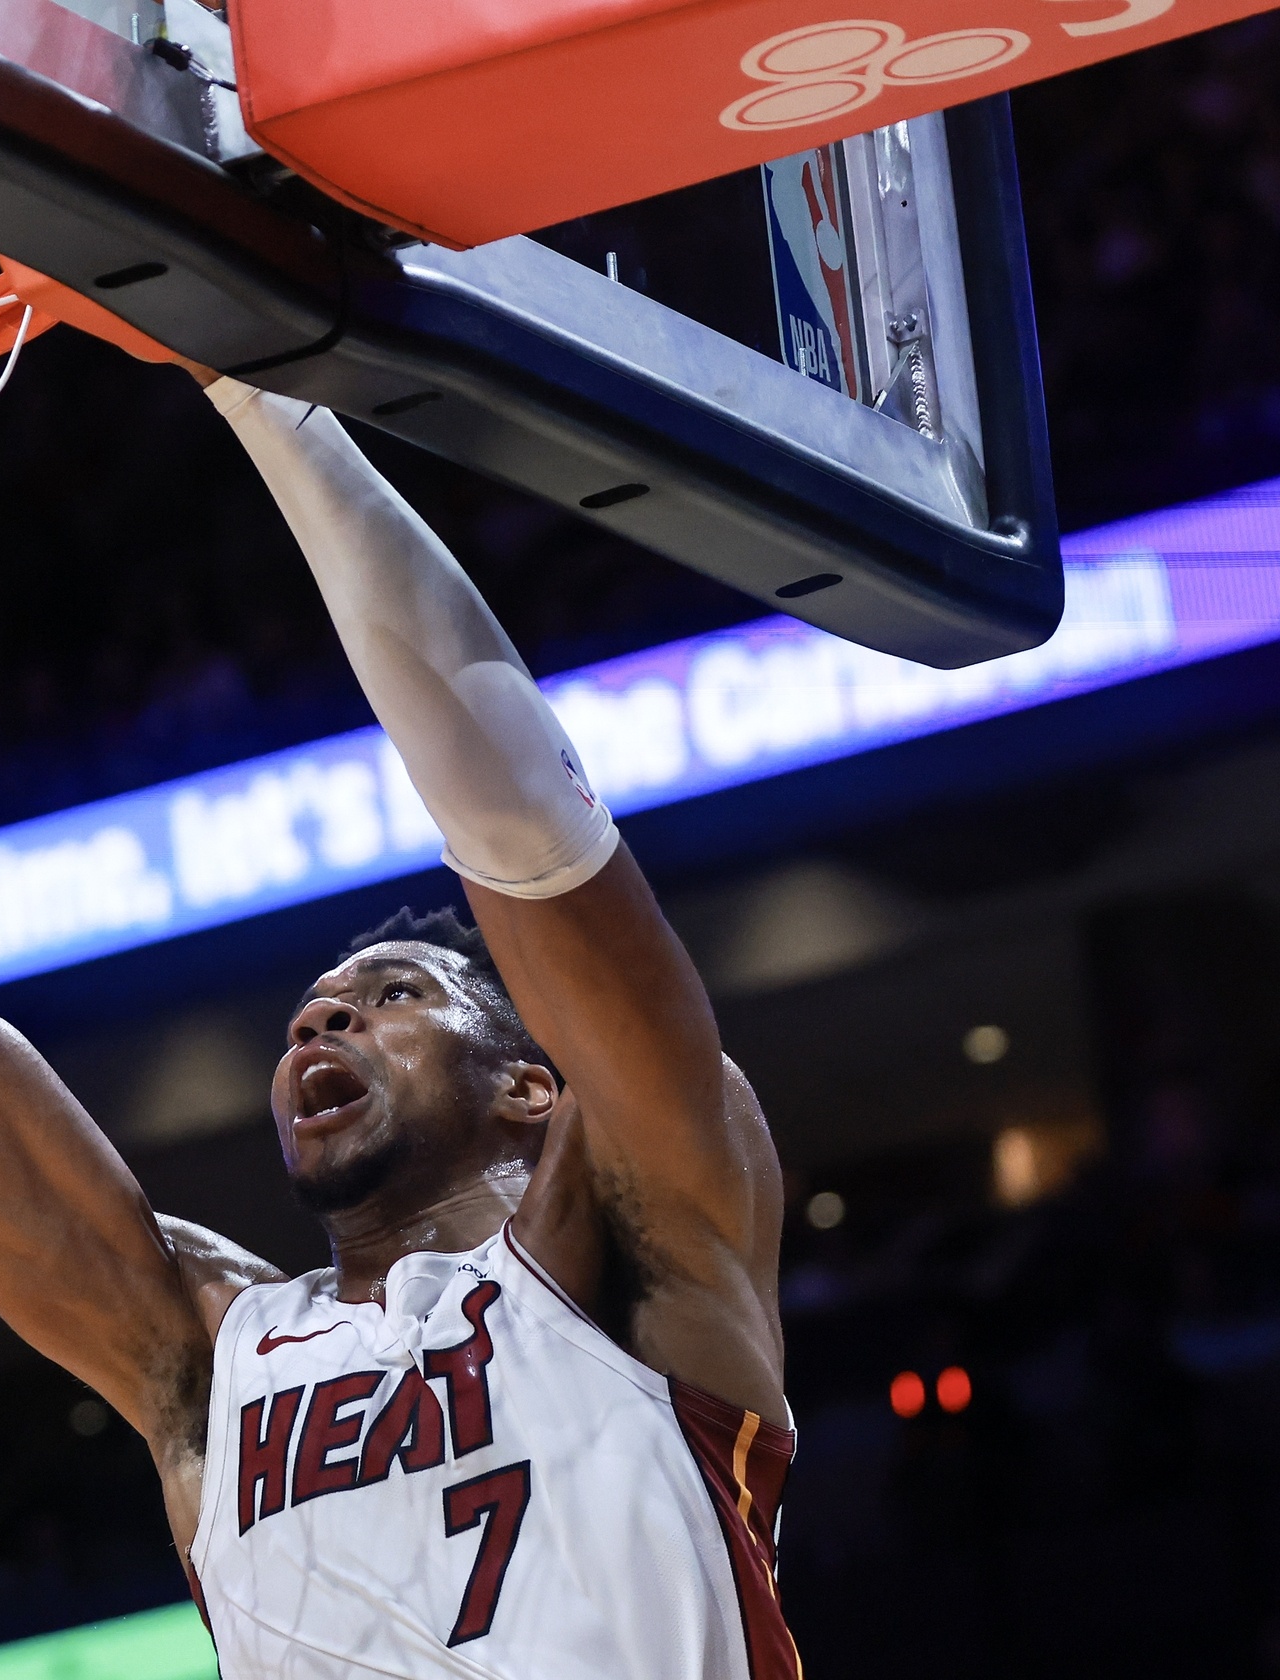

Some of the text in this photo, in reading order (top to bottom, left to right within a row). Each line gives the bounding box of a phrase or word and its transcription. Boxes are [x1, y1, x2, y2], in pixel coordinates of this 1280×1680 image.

[789, 314, 832, 382] NBA
[238, 1280, 502, 1537] HEAT
[442, 1459, 531, 1649] 7
